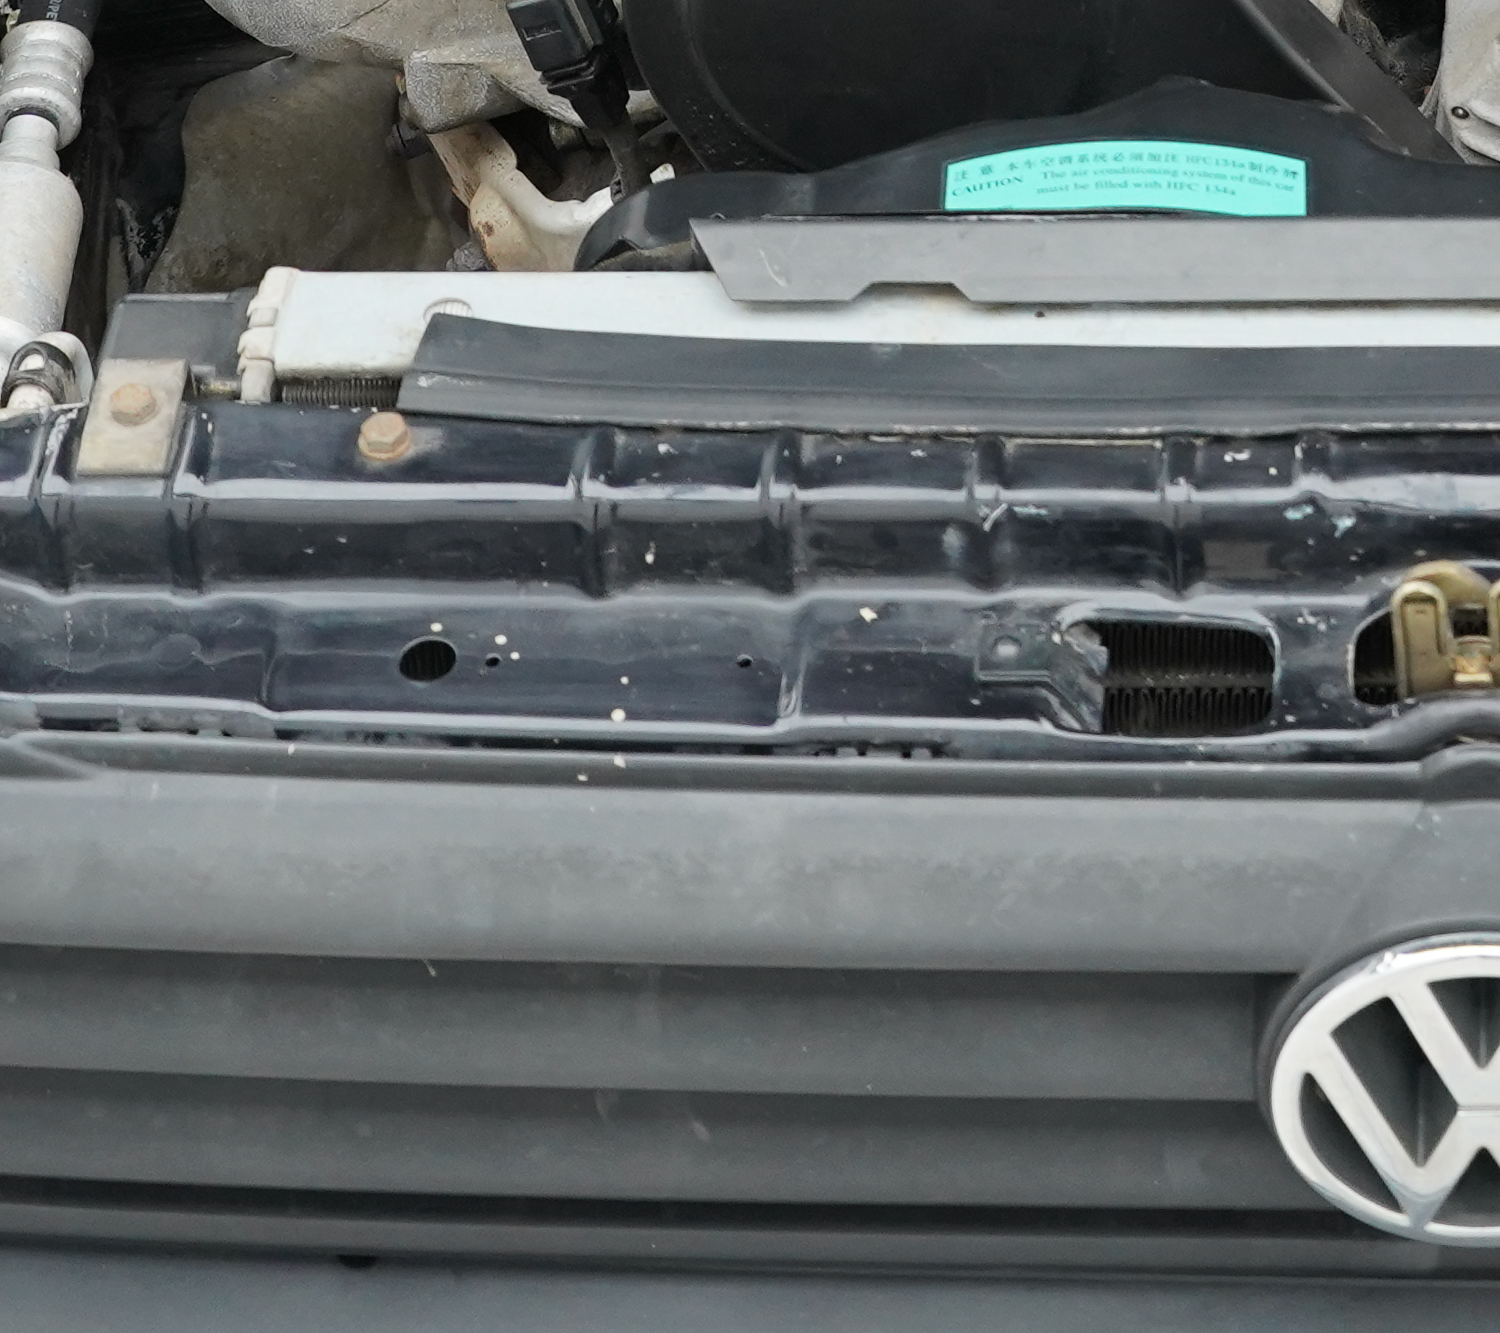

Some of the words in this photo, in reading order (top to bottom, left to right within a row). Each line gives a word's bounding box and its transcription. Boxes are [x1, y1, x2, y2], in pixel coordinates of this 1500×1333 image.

[951, 175, 1024, 197] CAUTION
[1042, 170, 1067, 180] The
[1071, 169, 1089, 177] air
[1093, 165, 1180, 178] conditioning
[1182, 168, 1229, 181] system
[1230, 173, 1246, 183] of
[1248, 176, 1272, 187] this
[1274, 182, 1295, 193] car
[955, 164, 994, 181] 注意
[1185, 155, 1245, 170] HFC134a
[1037, 185, 1070, 195] must
[1073, 181, 1089, 191] be
[1094, 180, 1128, 191] filled
[1132, 180, 1162, 190] with
[1166, 181, 1198, 192] HFC
[1204, 183, 1237, 196] 134a
